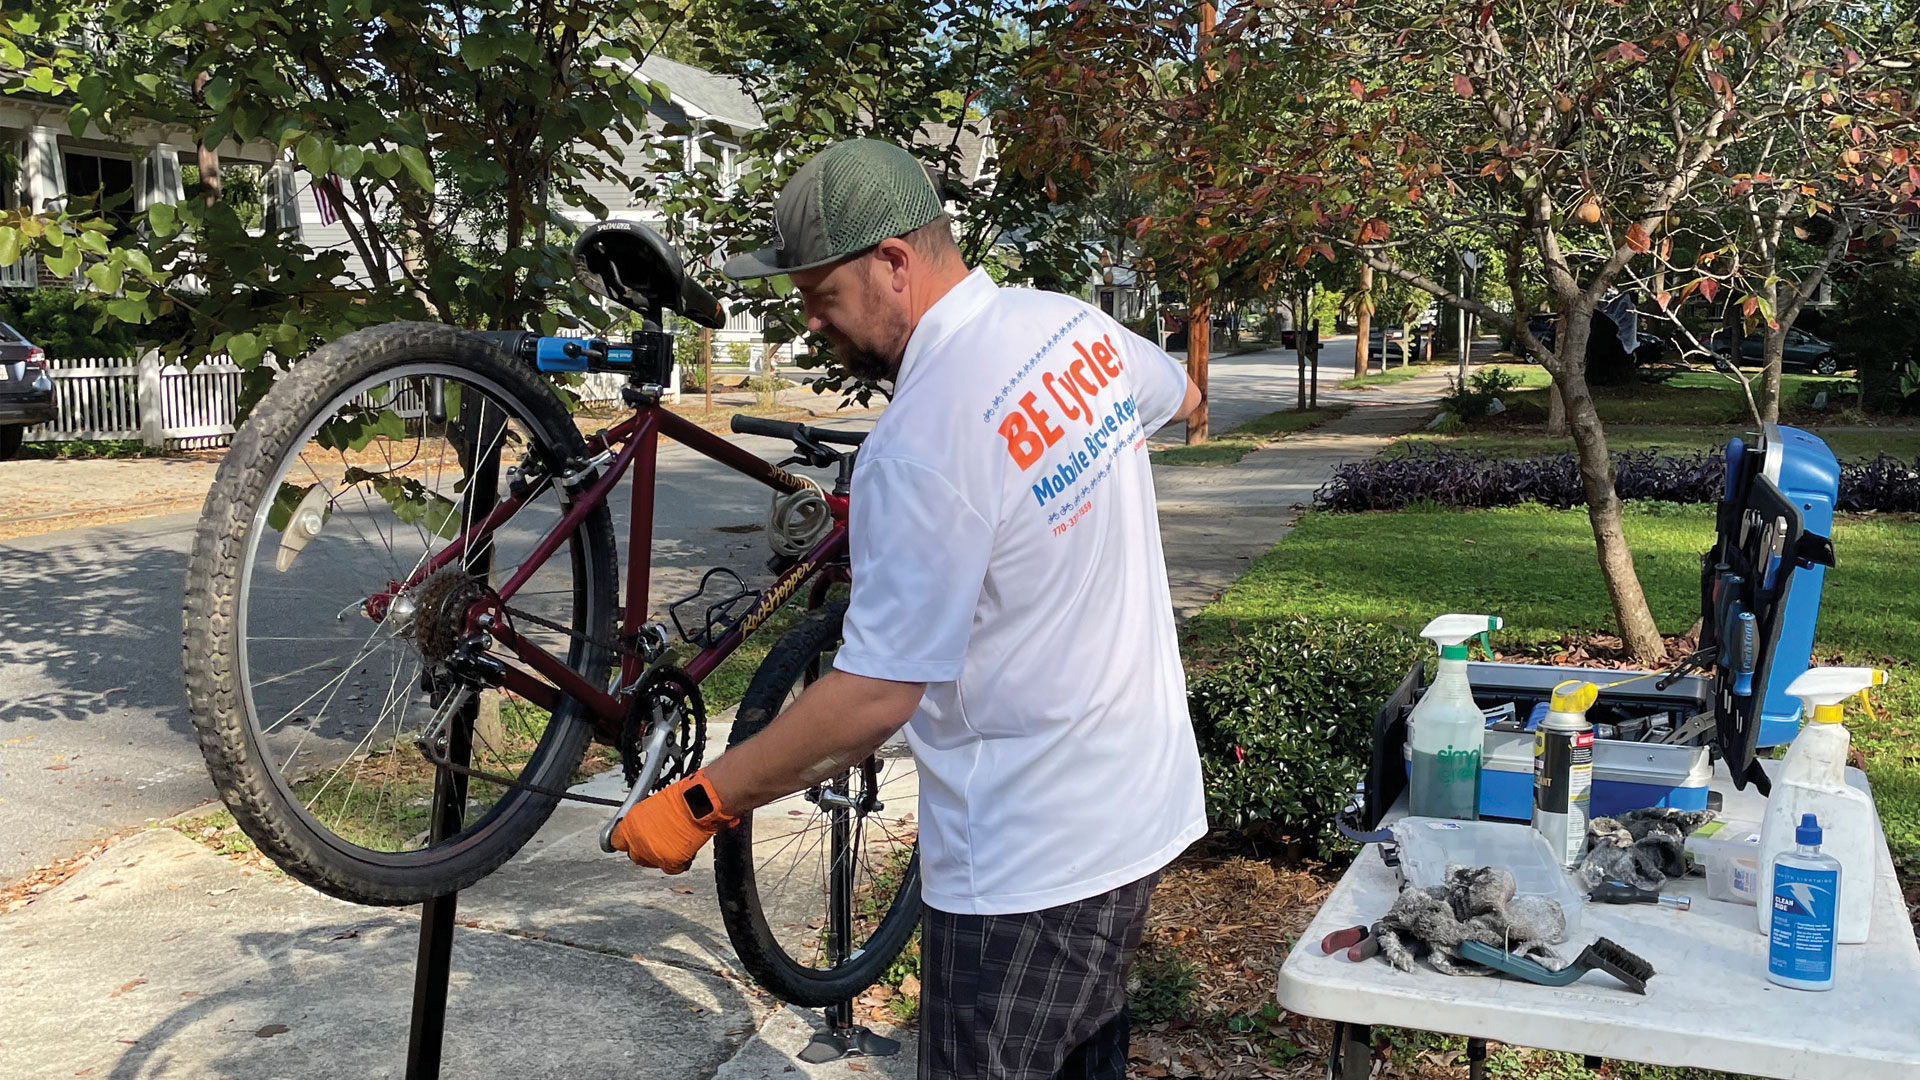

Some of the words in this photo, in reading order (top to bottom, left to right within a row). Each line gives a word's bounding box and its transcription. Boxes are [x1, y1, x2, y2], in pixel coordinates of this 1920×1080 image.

[997, 391, 1066, 472] BE
[1031, 450, 1090, 507] Mobile
[1084, 415, 1118, 460] Bicle
[1113, 394, 1136, 425] Rep
[1775, 896, 1794, 906] CLEAN
